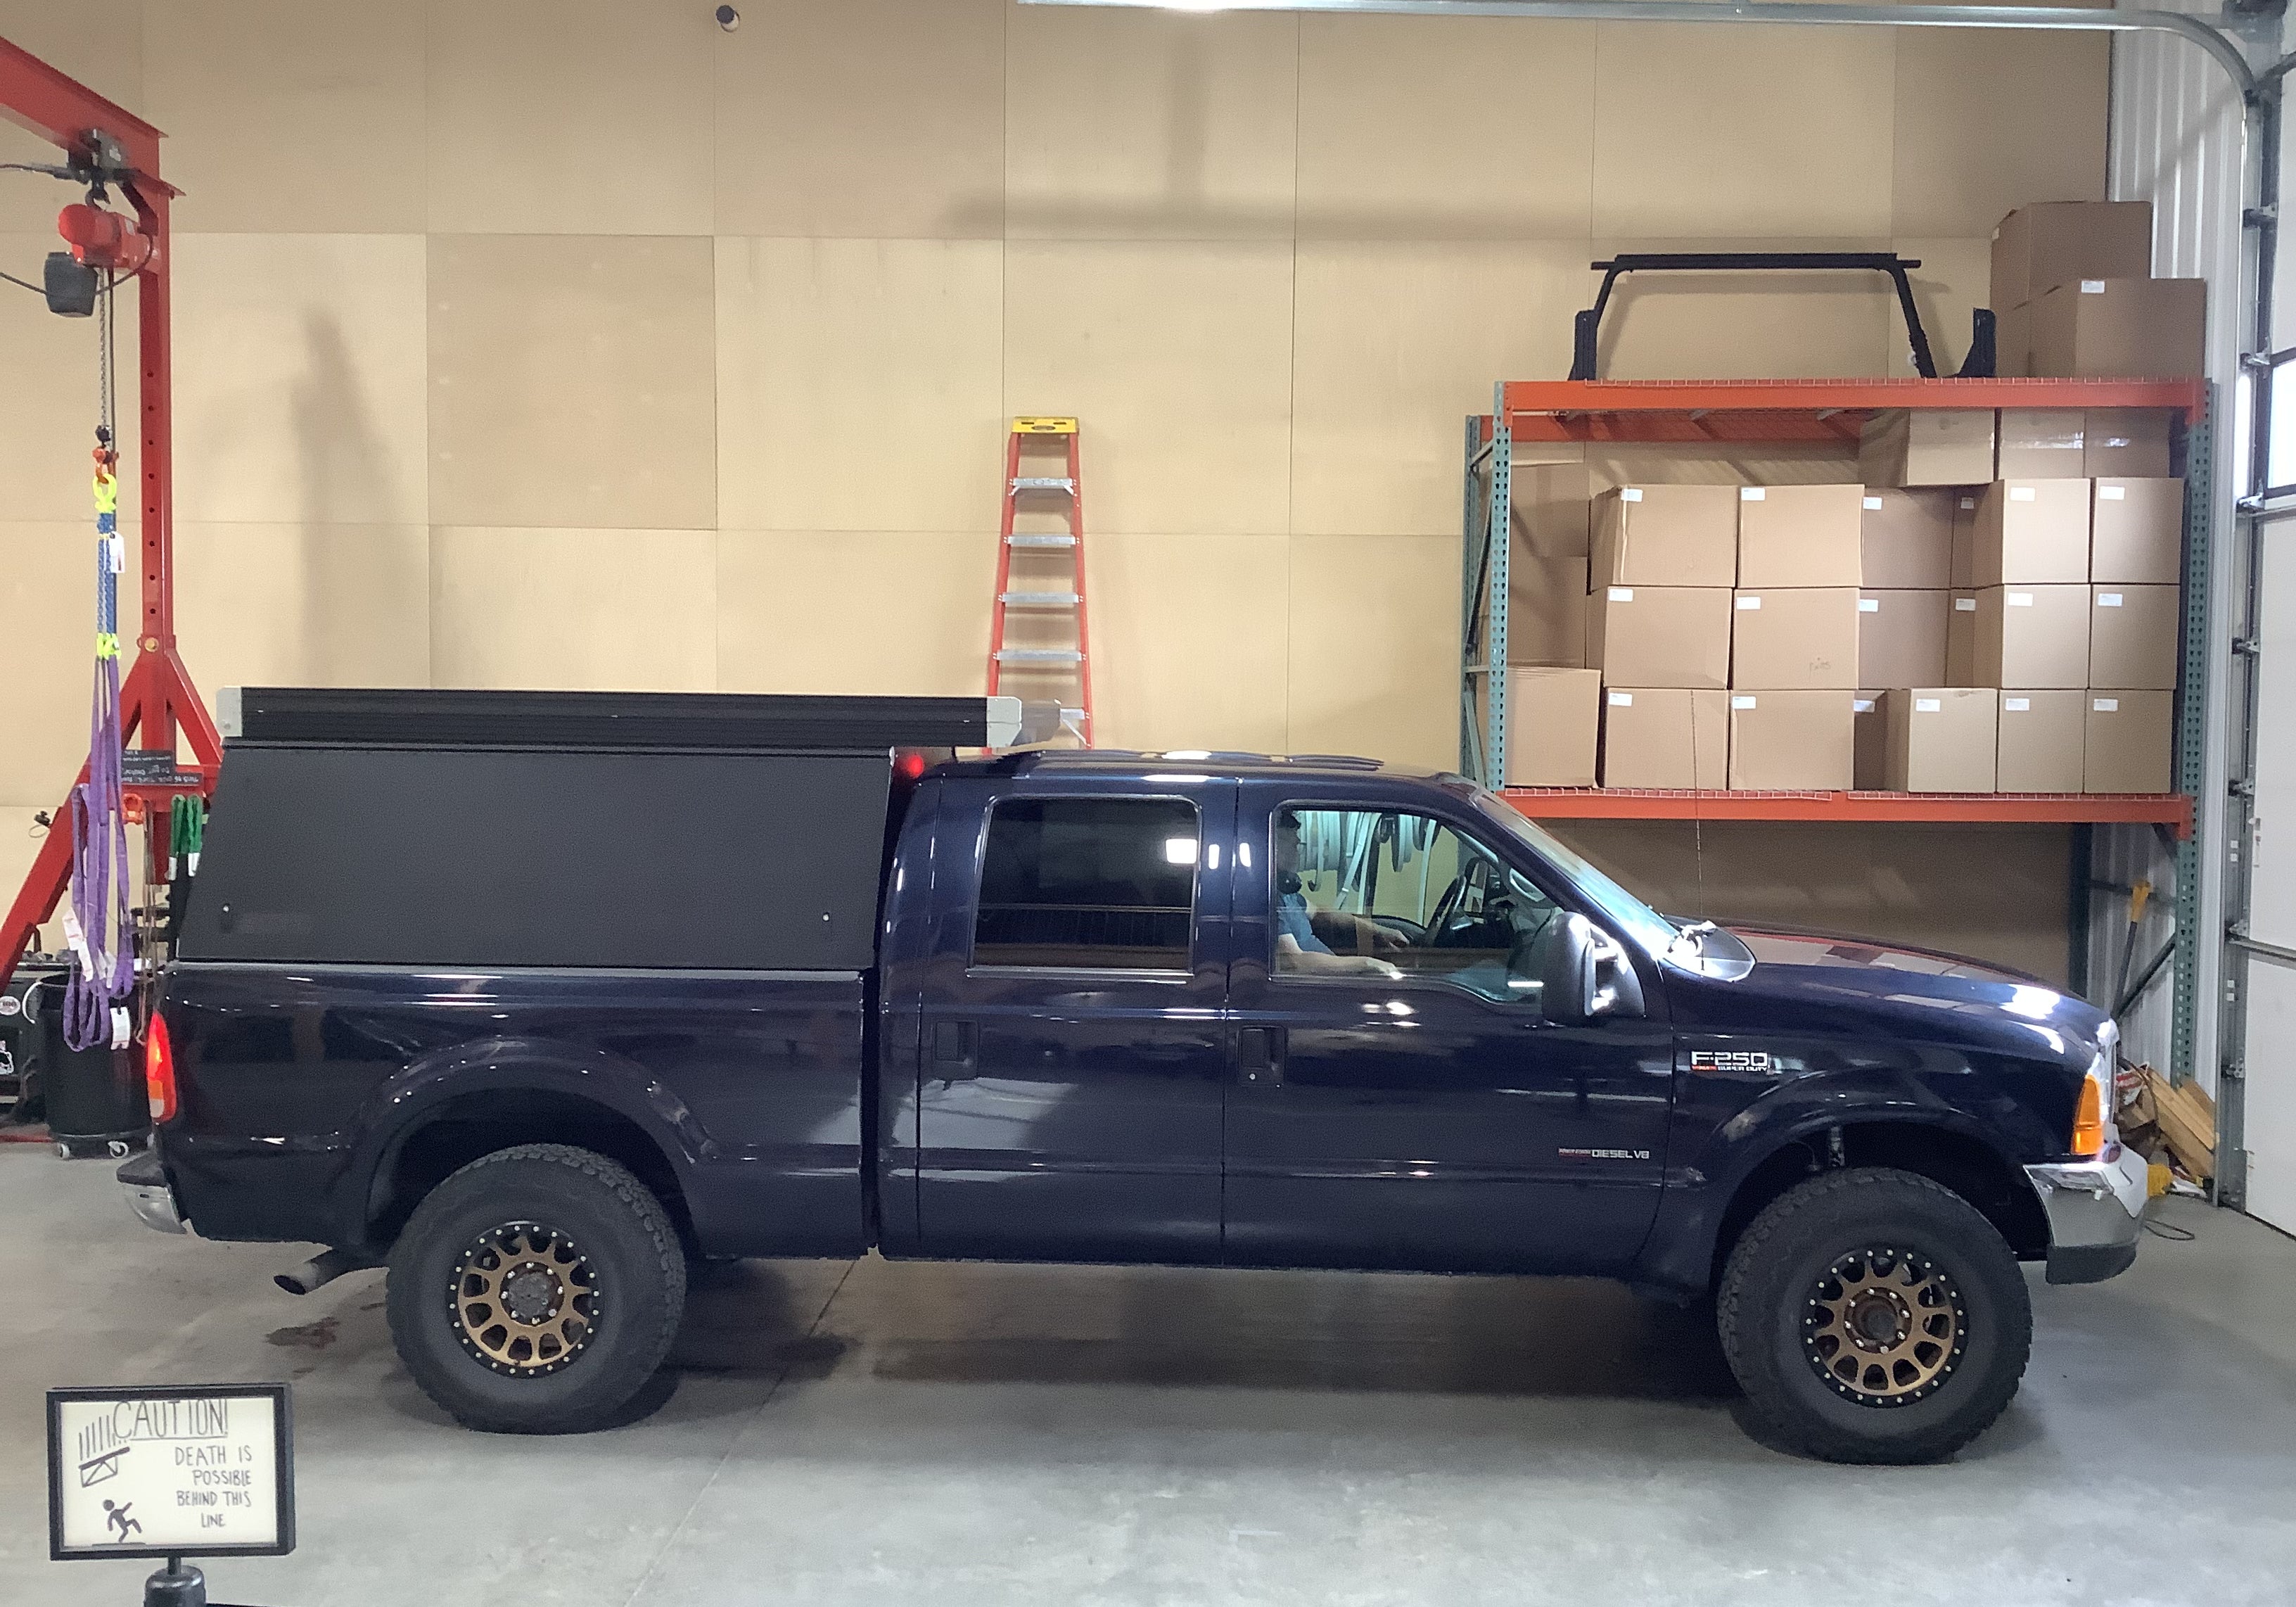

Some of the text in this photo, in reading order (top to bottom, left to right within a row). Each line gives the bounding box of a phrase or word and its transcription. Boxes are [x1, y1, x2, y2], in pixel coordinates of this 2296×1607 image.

[1591, 1149, 1633, 1159] DIESEL
[1633, 1150, 1650, 1160] V8
[113, 1399, 229, 1439] CAUTION!
[174, 1444, 253, 1466] DEATH IS
[191, 1469, 252, 1487] POSSIBLE
[176, 1490, 253, 1508] BEHIND THIS
[200, 1511, 227, 1528] LINE
